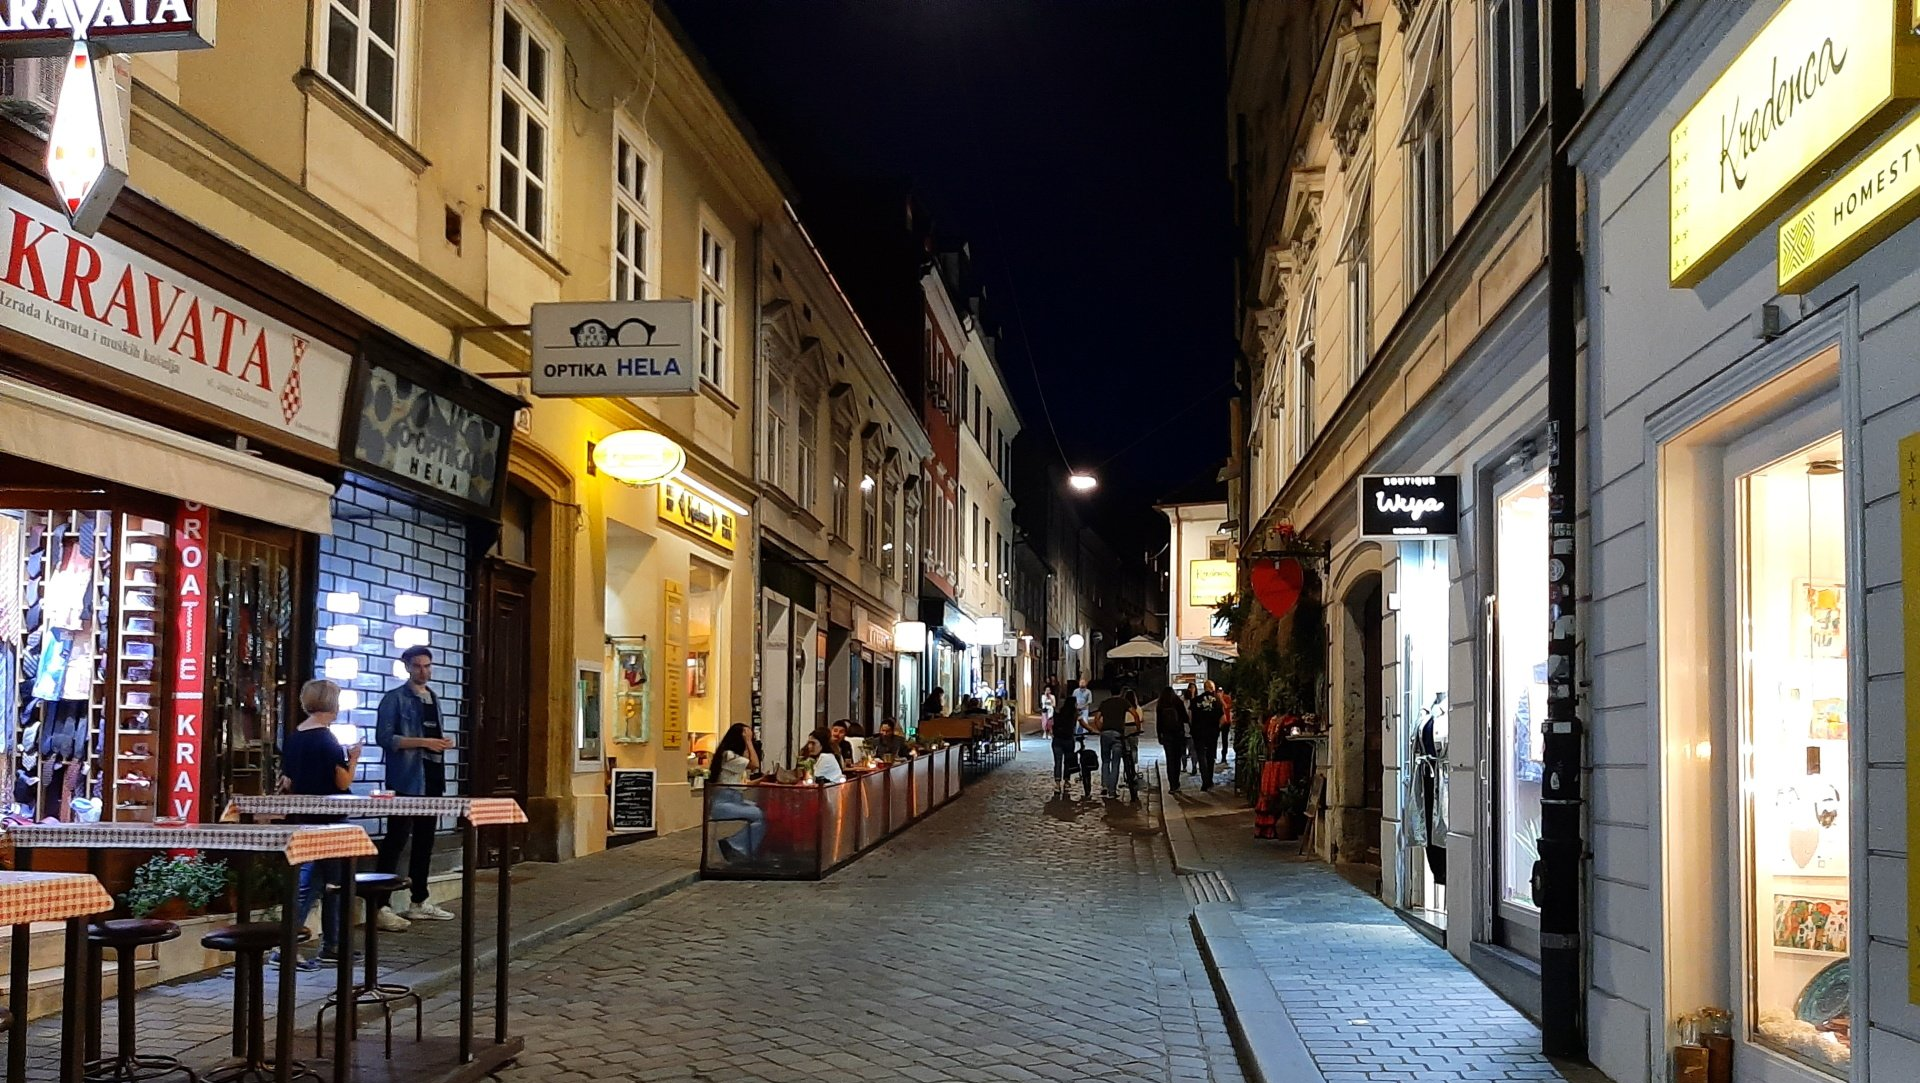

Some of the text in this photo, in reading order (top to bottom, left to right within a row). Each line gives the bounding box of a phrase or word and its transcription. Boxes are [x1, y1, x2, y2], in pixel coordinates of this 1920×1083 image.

[1719, 36, 1849, 194] Kredenca
[0, 207, 273, 393] KRAVATA
[0, 290, 41, 319] Izrada
[45, 309, 90, 339] kravata
[92, 329, 97, 342] i
[544, 357, 681, 378] OPTIKA HELA
[409, 456, 458, 491] HELA
[1383, 476, 1436, 487] BOUTIQUE
